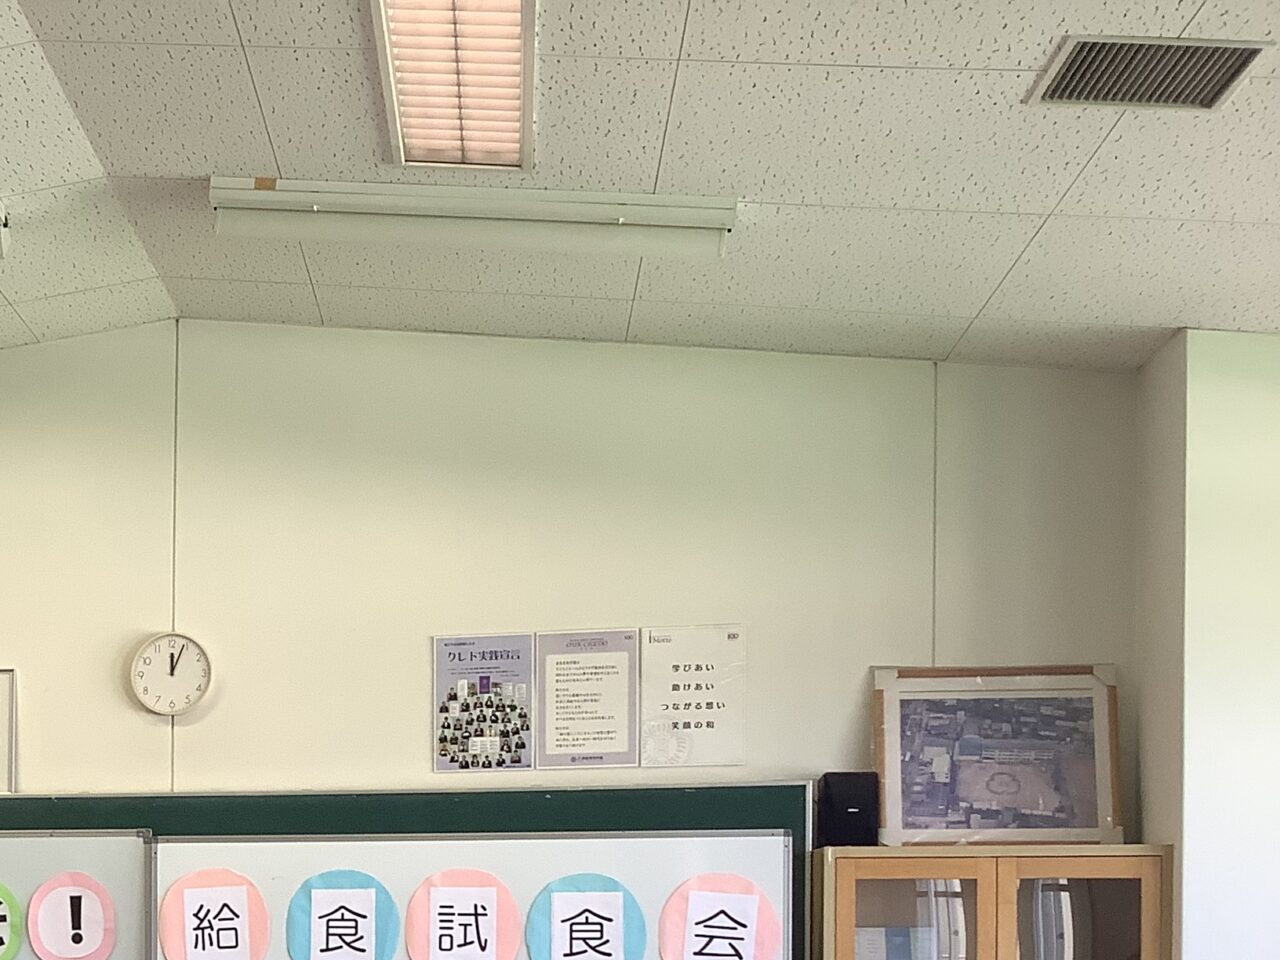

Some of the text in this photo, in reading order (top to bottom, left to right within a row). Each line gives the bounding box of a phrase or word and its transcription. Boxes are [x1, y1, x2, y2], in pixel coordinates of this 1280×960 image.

[155, 644, 160, 653] 11
[169, 640, 176, 648] 12
[185, 642, 189, 651] 1
[196, 653, 202, 662] 2
[448, 649, 520, 662] クレド実践宣言
[143, 656, 152, 666] 10
[672, 664, 714, 672] 学びあい
[138, 671, 144, 680] 9
[201, 669, 207, 678] 3
[143, 686, 148, 695] 8
[672, 683, 714, 691] 助けあい
[154, 696, 161, 707] 7
[169, 700, 175, 708] 6
[184, 695, 191, 704] 5
[660, 701, 725, 710] つながる想い
[672, 721, 714, 729] 笑顔の和
[192, 903, 749, 960] 給食試食会
